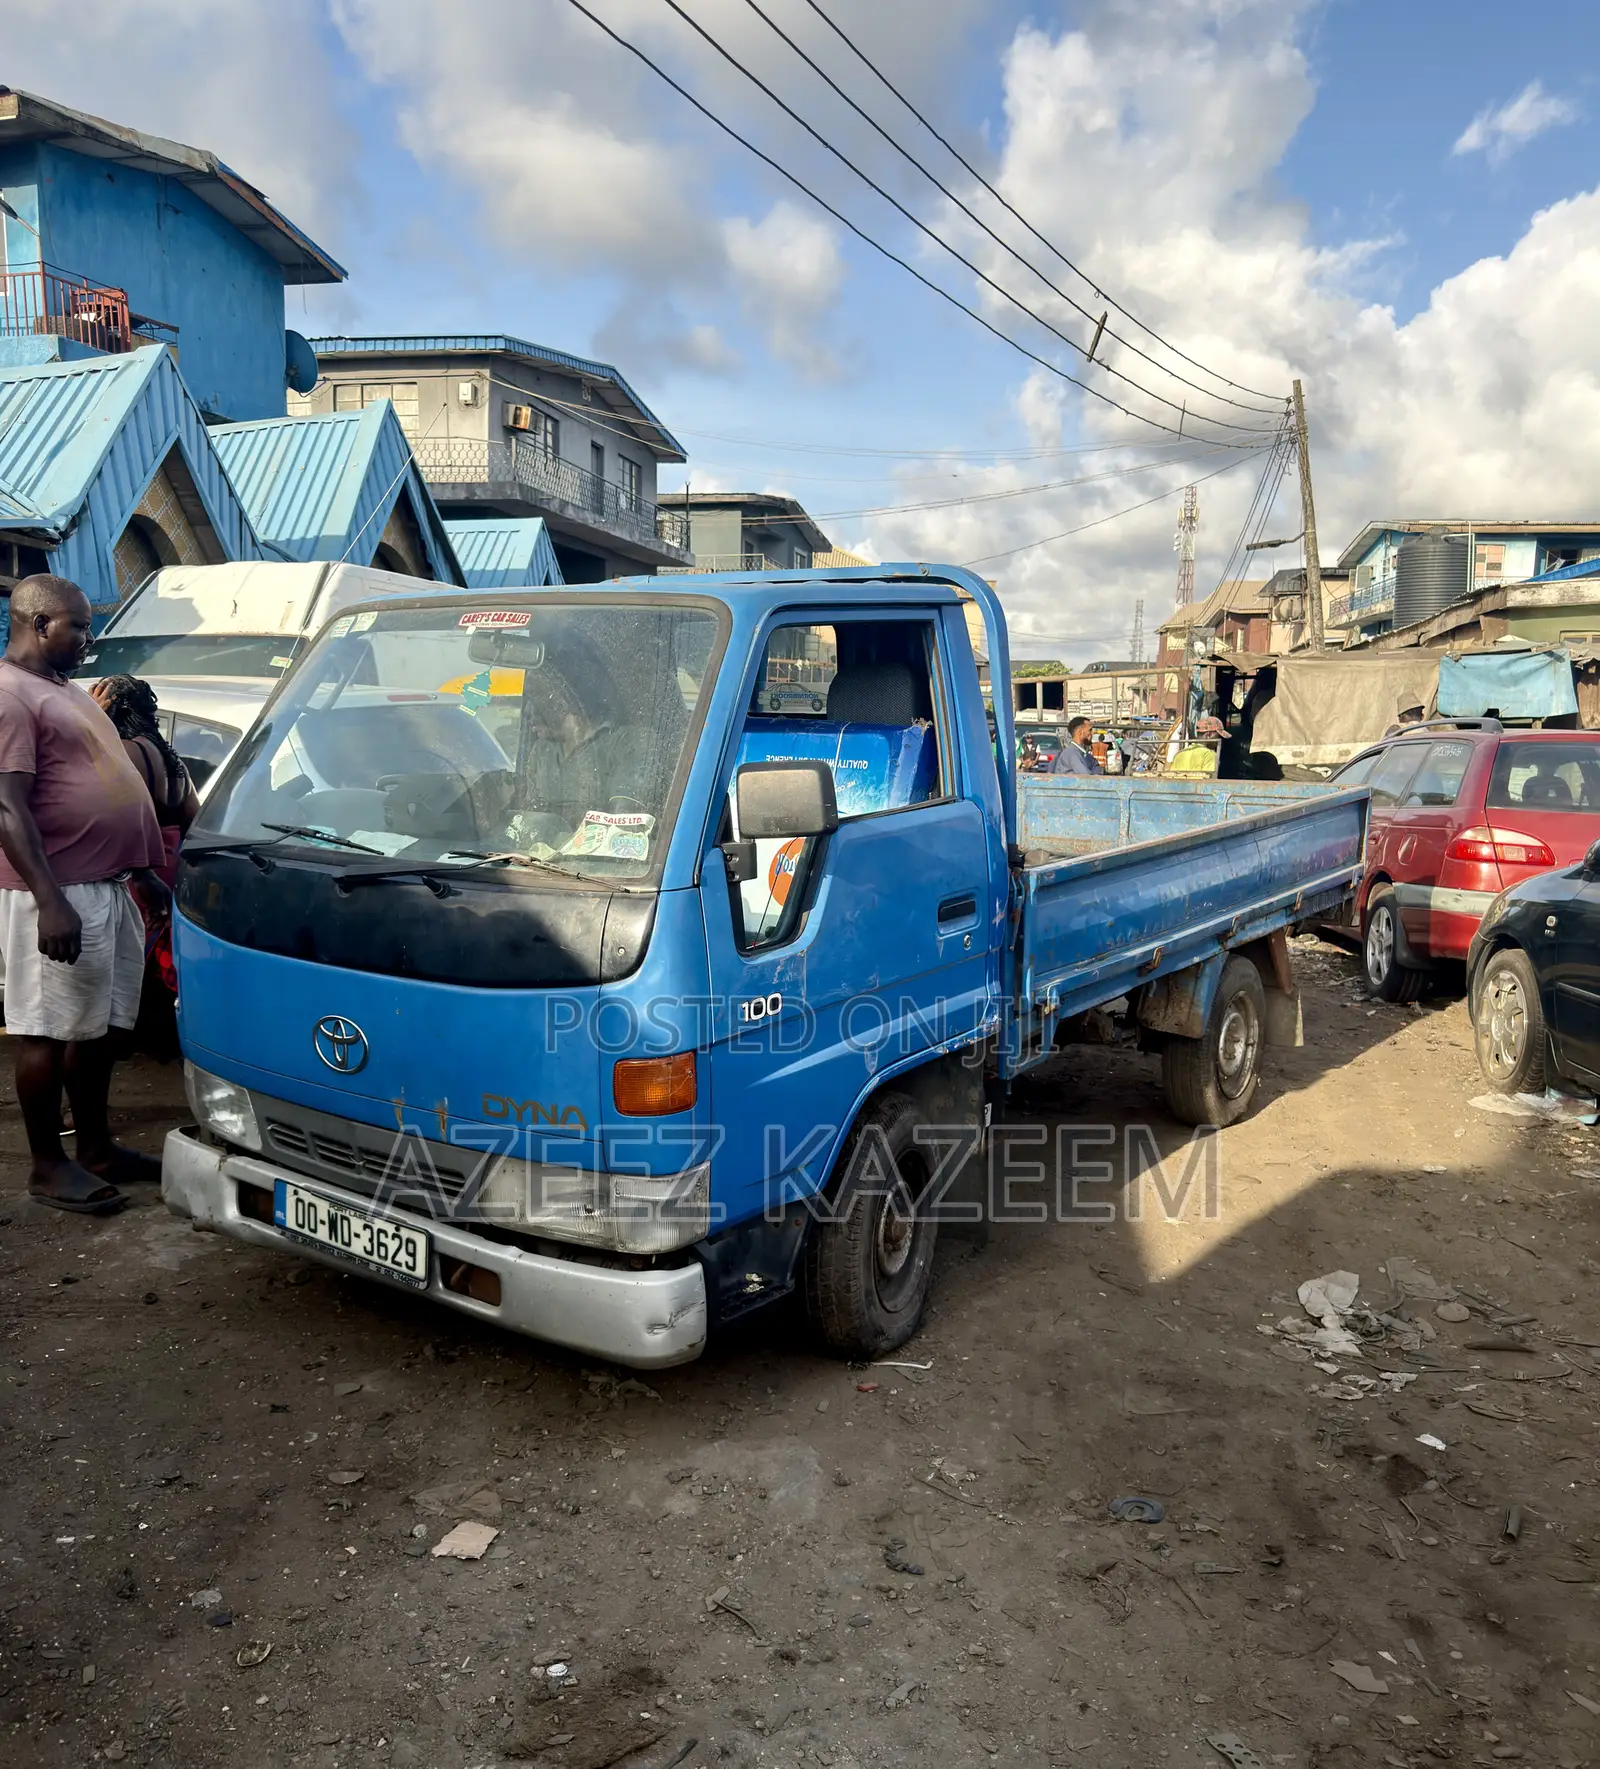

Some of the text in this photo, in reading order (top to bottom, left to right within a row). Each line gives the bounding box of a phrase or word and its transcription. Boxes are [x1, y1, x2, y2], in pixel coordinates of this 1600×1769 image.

[461, 613, 491, 624] CAREY'S
[492, 612, 506, 622] CAR
[506, 613, 530, 624] SALES
[837, 759, 868, 770] QUALITY
[603, 816, 627, 824] SALES
[741, 992, 783, 1023] 100
[482, 1093, 588, 1130] DYNA
[295, 1197, 417, 1272] 00-WD-3629
